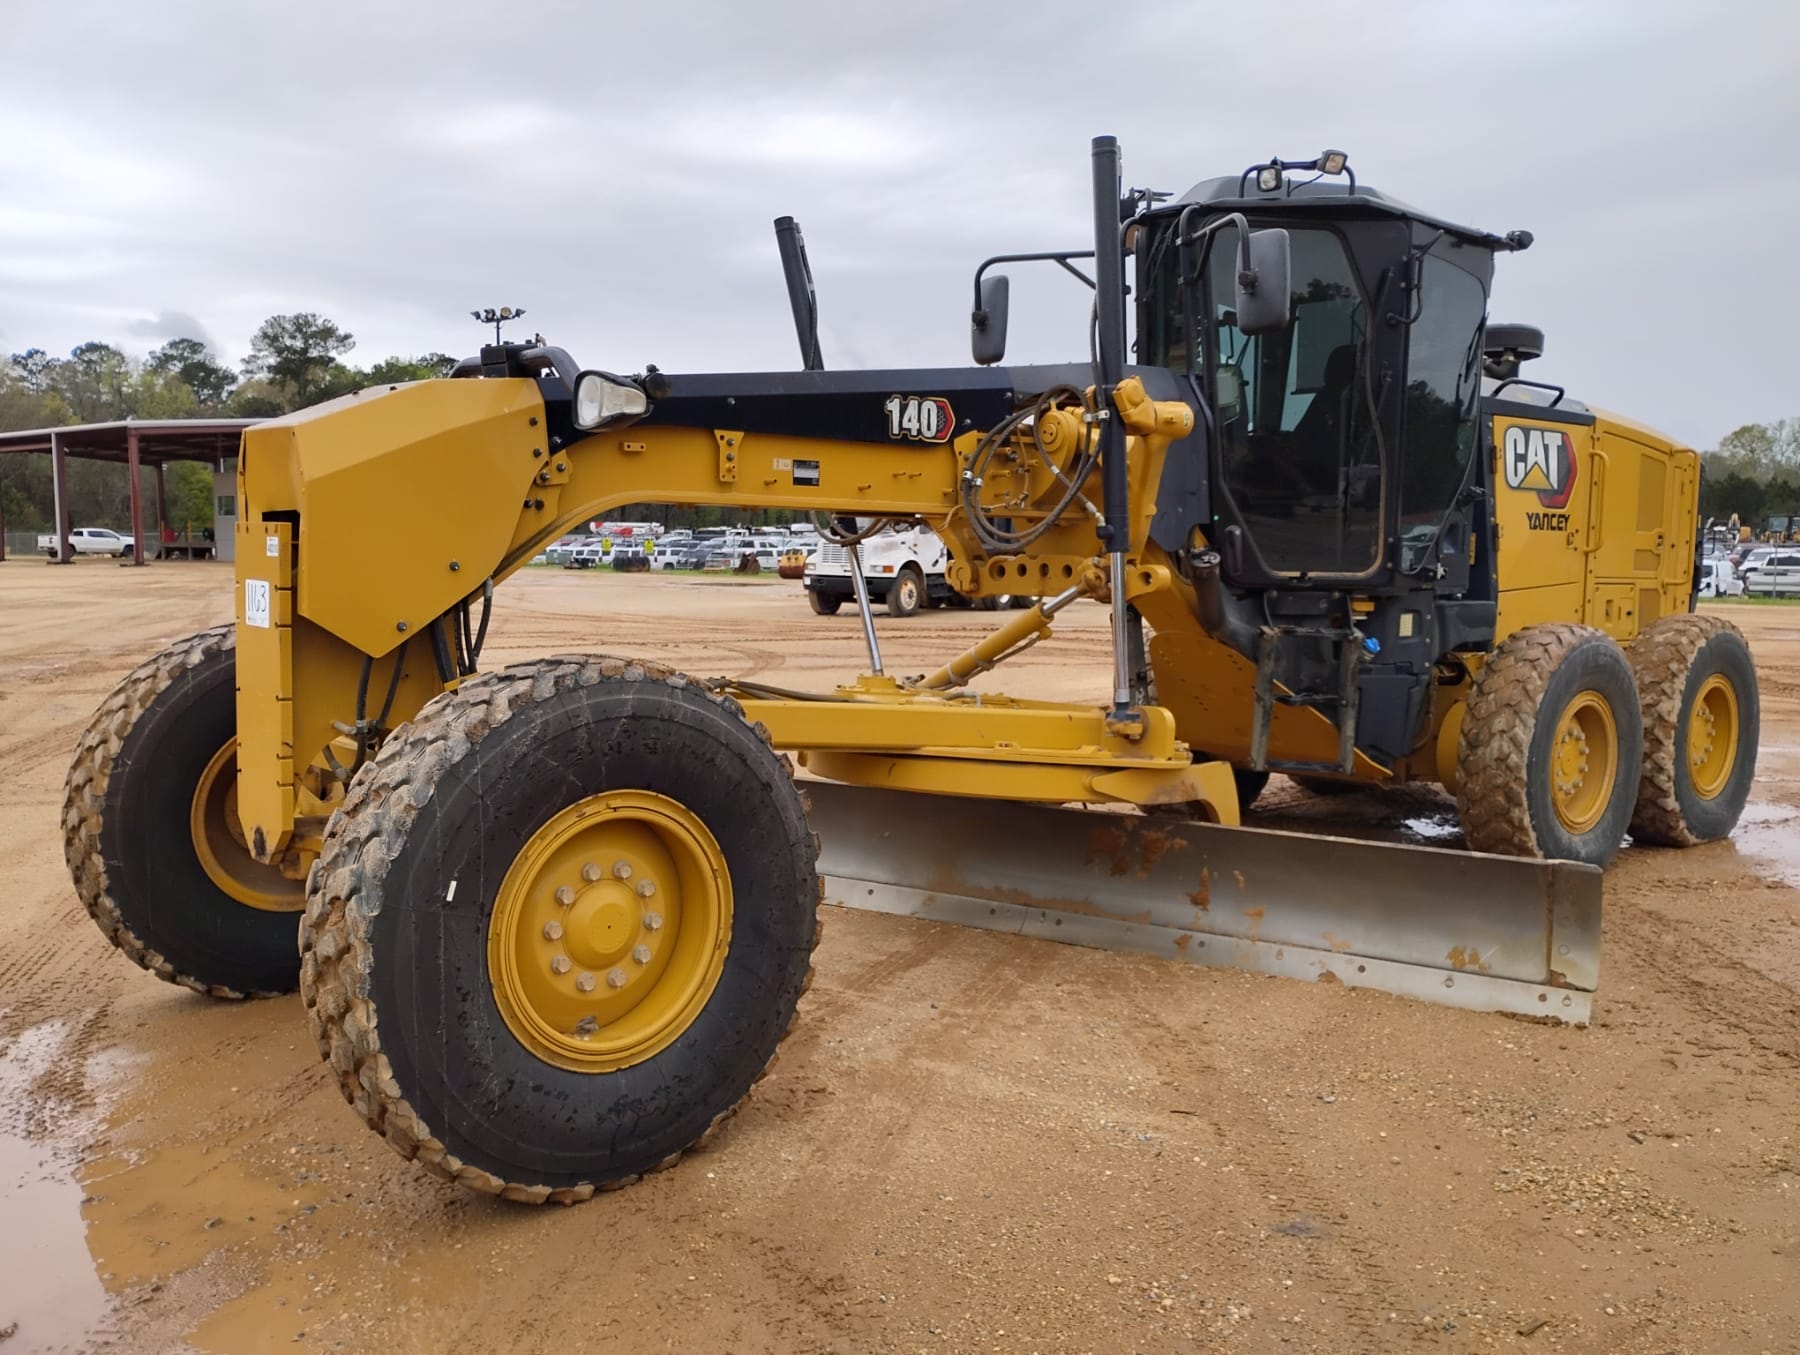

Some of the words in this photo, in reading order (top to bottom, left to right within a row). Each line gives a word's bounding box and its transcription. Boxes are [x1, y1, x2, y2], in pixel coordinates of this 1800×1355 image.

[886, 398, 938, 438] 140
[1505, 426, 1562, 491] CAT
[1526, 512, 1570, 531] YANCEY
